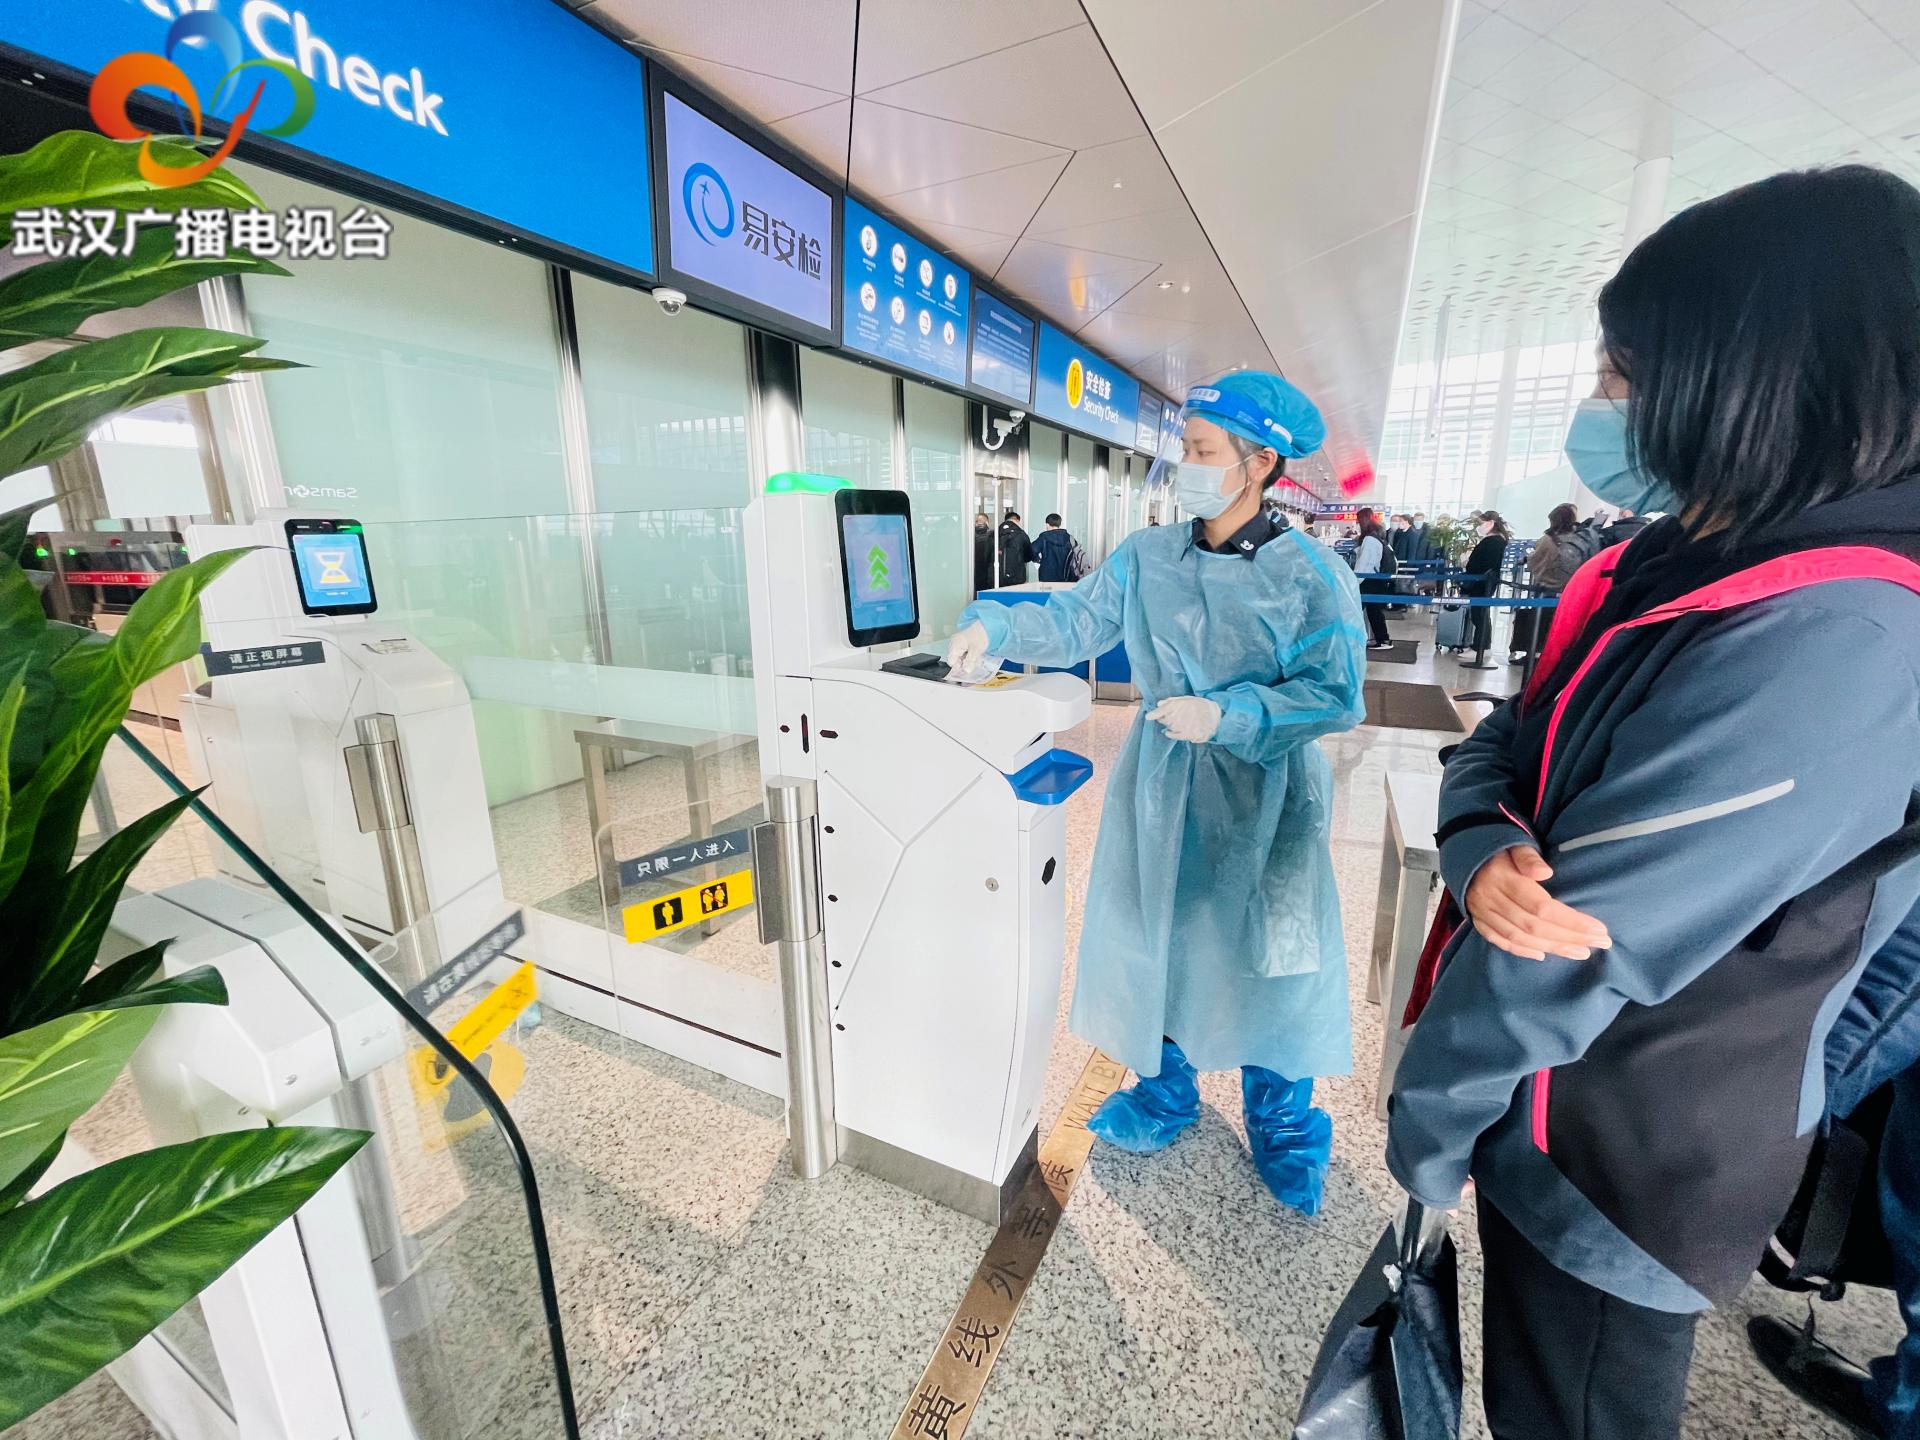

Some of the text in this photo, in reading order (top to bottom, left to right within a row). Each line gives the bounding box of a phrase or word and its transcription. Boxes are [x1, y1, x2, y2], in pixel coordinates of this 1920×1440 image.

[241, 0, 449, 137] Check
[741, 200, 821, 280] 易安检
[1085, 371, 1112, 400] 安全检查
[1083, 396, 1119, 425] Security Check
[637, 840, 735, 877] 只限一人进入
